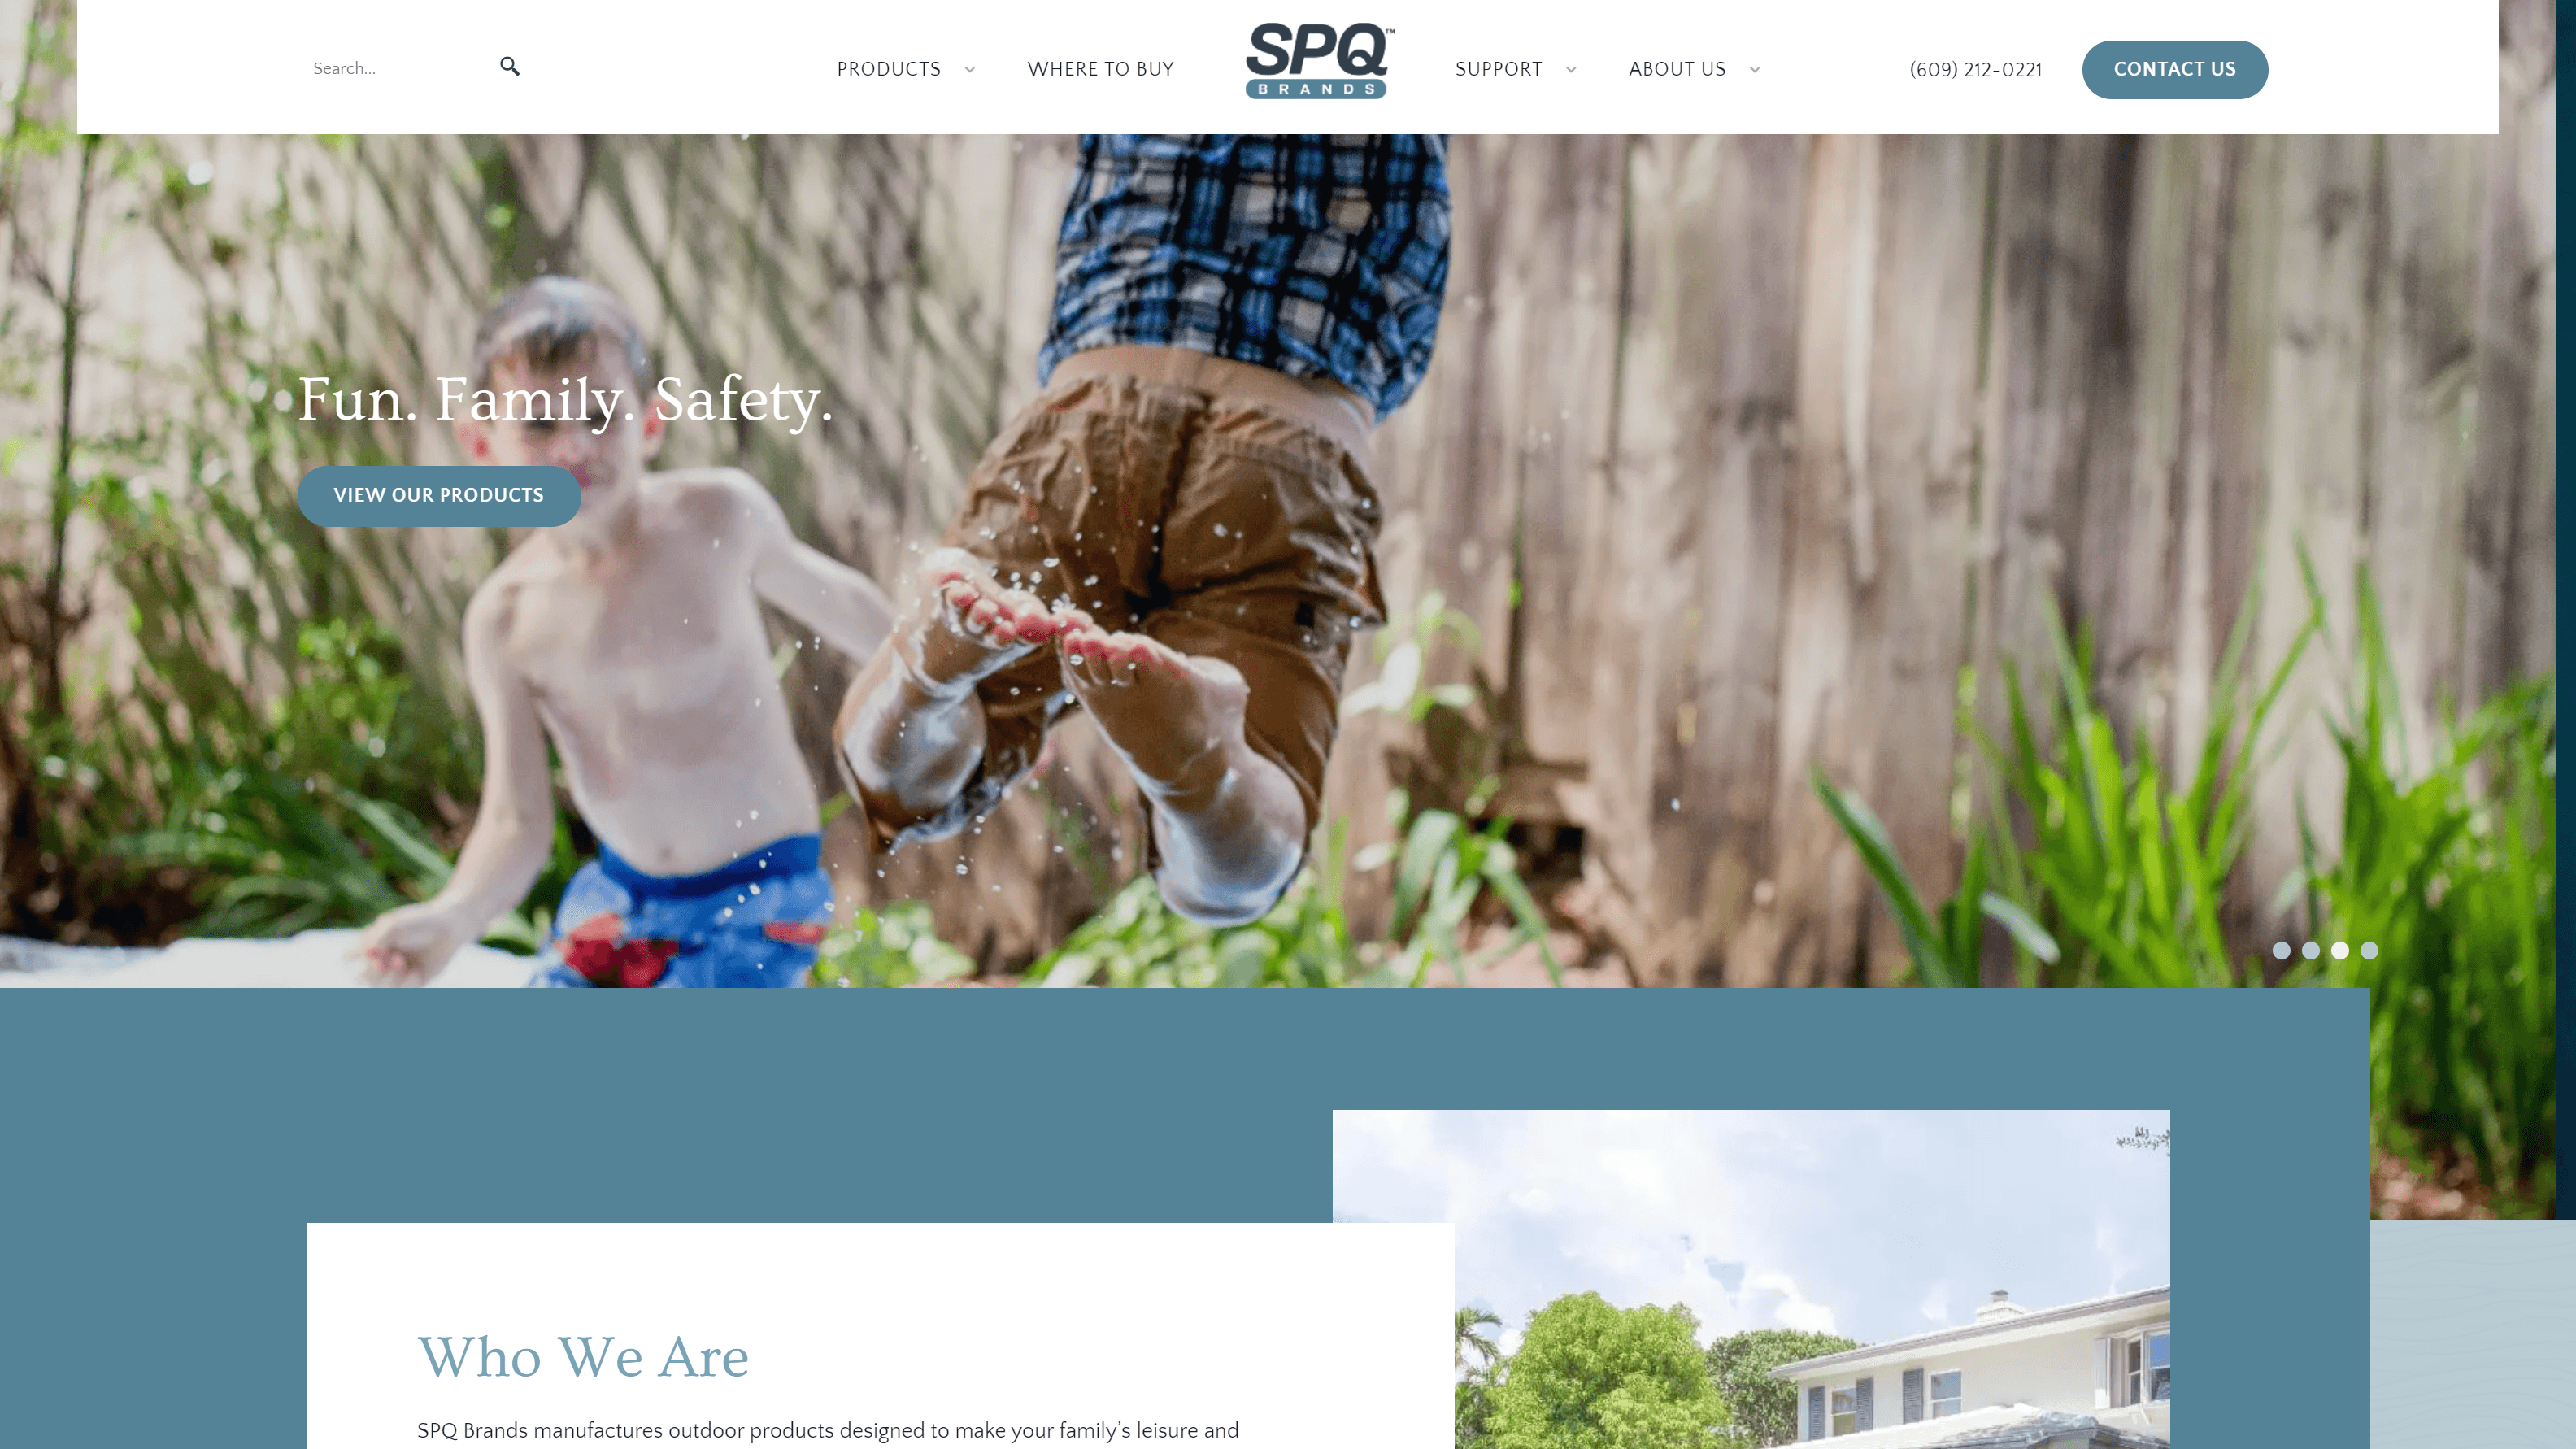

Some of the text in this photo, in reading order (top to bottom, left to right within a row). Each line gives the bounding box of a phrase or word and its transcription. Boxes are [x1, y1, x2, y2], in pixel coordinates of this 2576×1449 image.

[1246, 22, 1388, 76] SPQ
[314, 60, 376, 75] Search...
[838, 61, 941, 76] PRODUCTS
[1027, 61, 1175, 76] WHERE TO BUY
[1456, 61, 1543, 76] SUPPORT
[1629, 61, 1726, 76] ABOUT US
[1910, 61, 2042, 80] (609) 212-0221
[2114, 61, 2236, 76] CONTACT US
[1258, 84, 1375, 95] BRANDS
[299, 373, 833, 435] Fun. Family. Safety.
[333, 487, 544, 503] VIEW OUR PRODUCTS
[417, 1334, 748, 1378] Who We Are
[417, 1422, 459, 1441] SPQ
[464, 1421, 528, 1438] Brands
[534, 1421, 663, 1438] manufactures
[668, 1421, 746, 1438] outdoor
[751, 1421, 834, 1444] products
[840, 1421, 925, 1444] designed
[930, 1423, 950, 1438] to
[956, 1421, 1006, 1438] make
[1010, 1426, 1055, 1444] your
[1138, 1421, 1199, 1438] leisure
[1204, 1421, 1238, 1438] and
